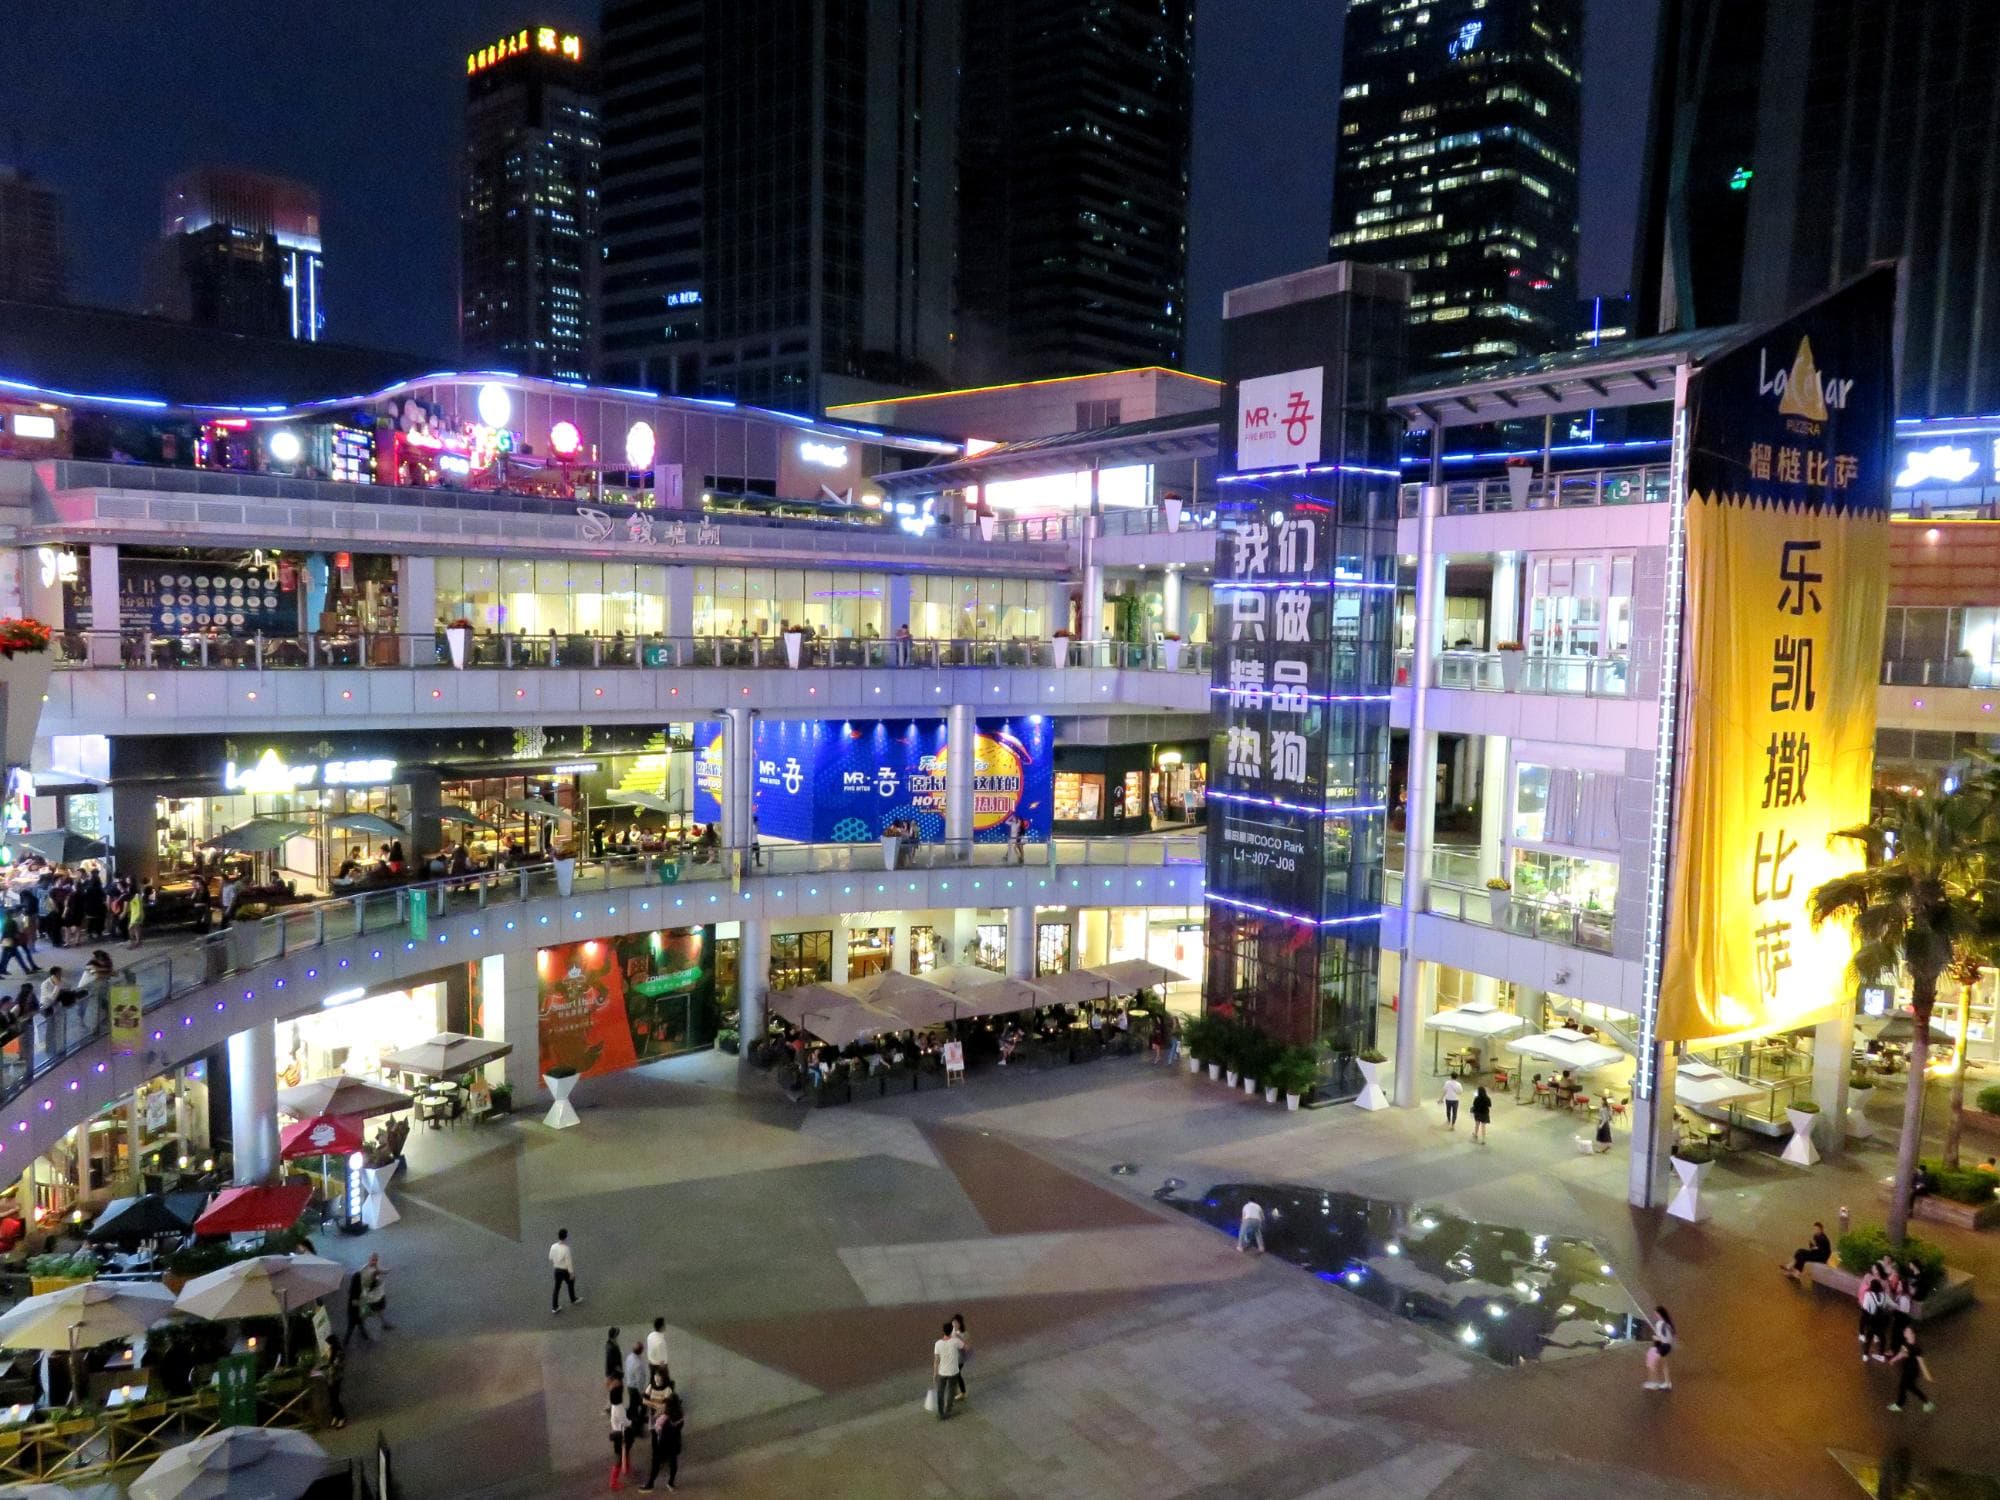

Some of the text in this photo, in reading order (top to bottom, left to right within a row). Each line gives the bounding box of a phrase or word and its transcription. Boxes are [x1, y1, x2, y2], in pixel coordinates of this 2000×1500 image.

[1234, 519, 1315, 575] 我们
[1232, 589, 1311, 643] 只做
[651, 649, 668, 665] L2
[1229, 658, 1309, 714] 精品
[1227, 725, 1307, 784] 热狗
[1752, 540, 1823, 1003] 乐凯撒比萨
[1233, 847, 1295, 872] L1-J07-J08
[1283, 840, 1305, 854] Park
